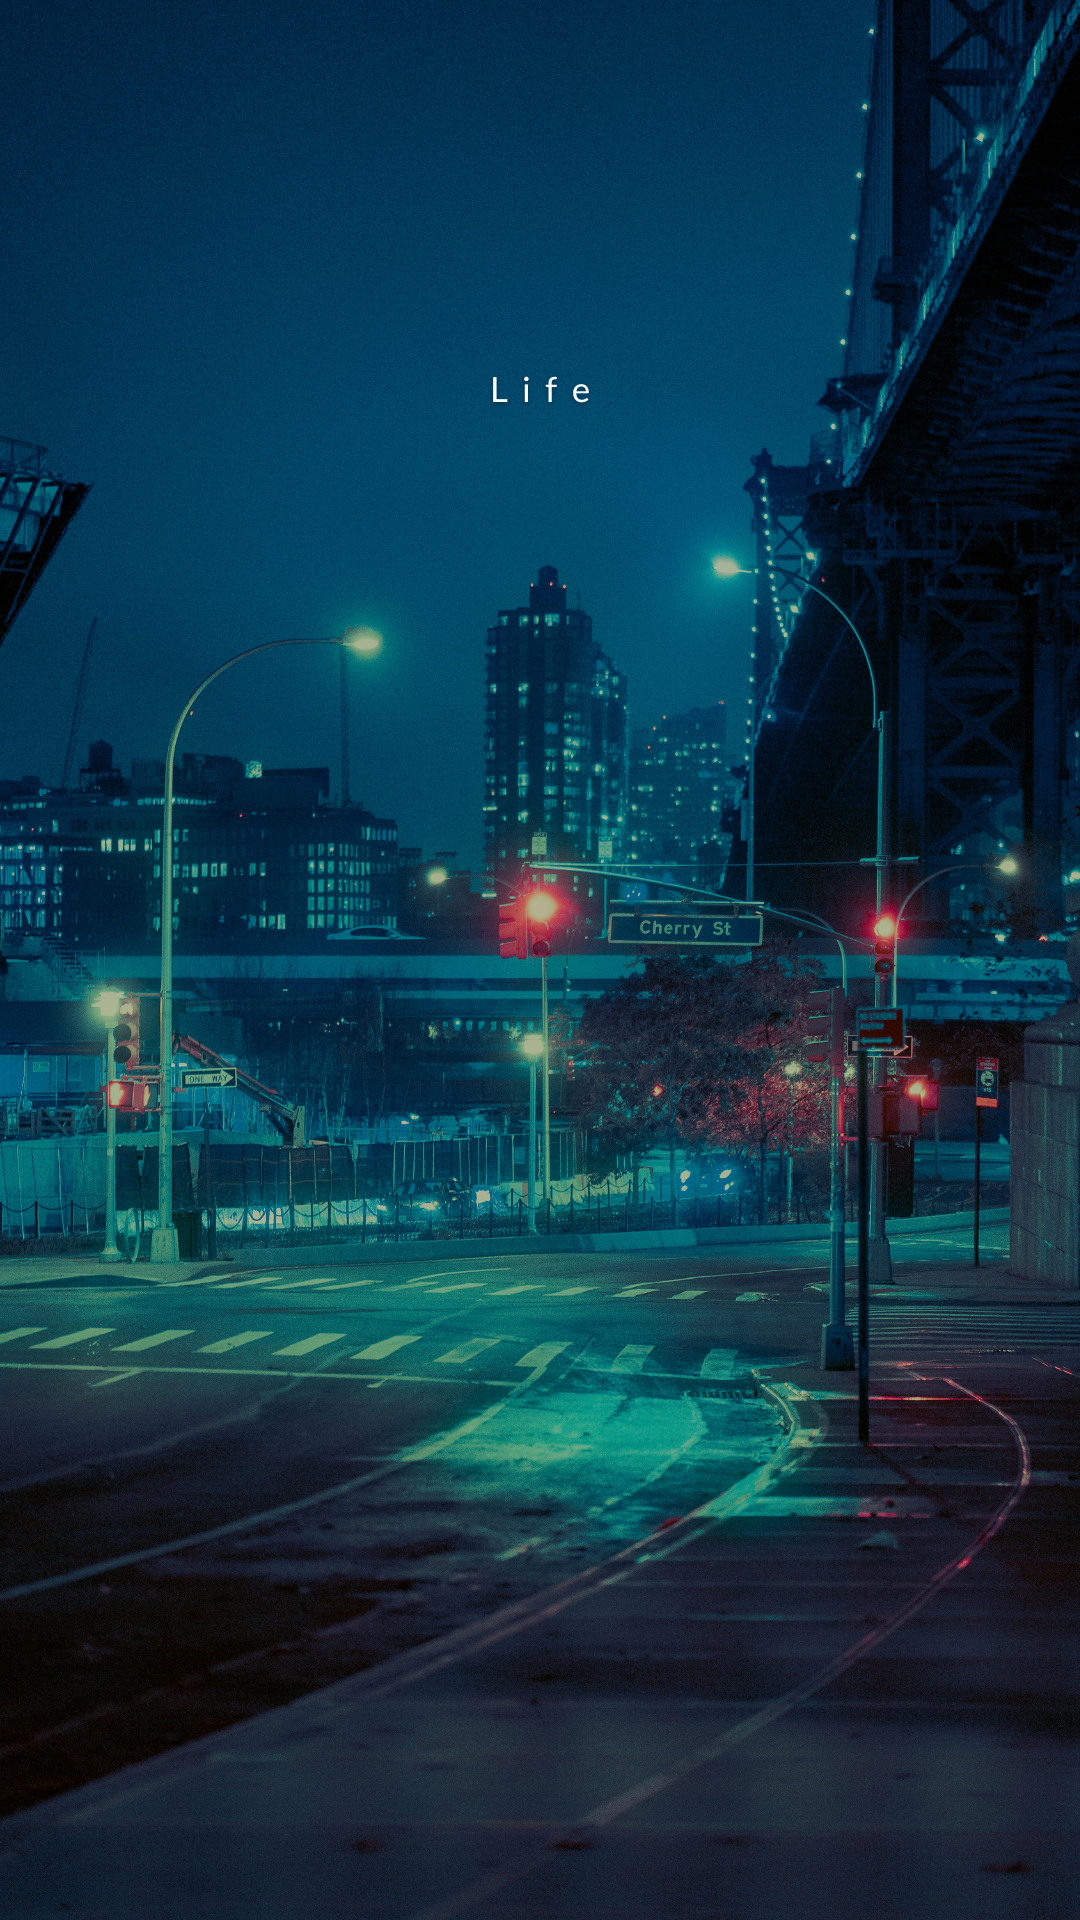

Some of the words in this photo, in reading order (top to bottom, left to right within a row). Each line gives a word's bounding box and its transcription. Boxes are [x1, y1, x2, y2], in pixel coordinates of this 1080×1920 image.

[639, 919, 703, 939] Cherry
[712, 921, 732, 936] St
[189, 1075, 205, 1083] ONE
[211, 1074, 228, 1082] WAY
